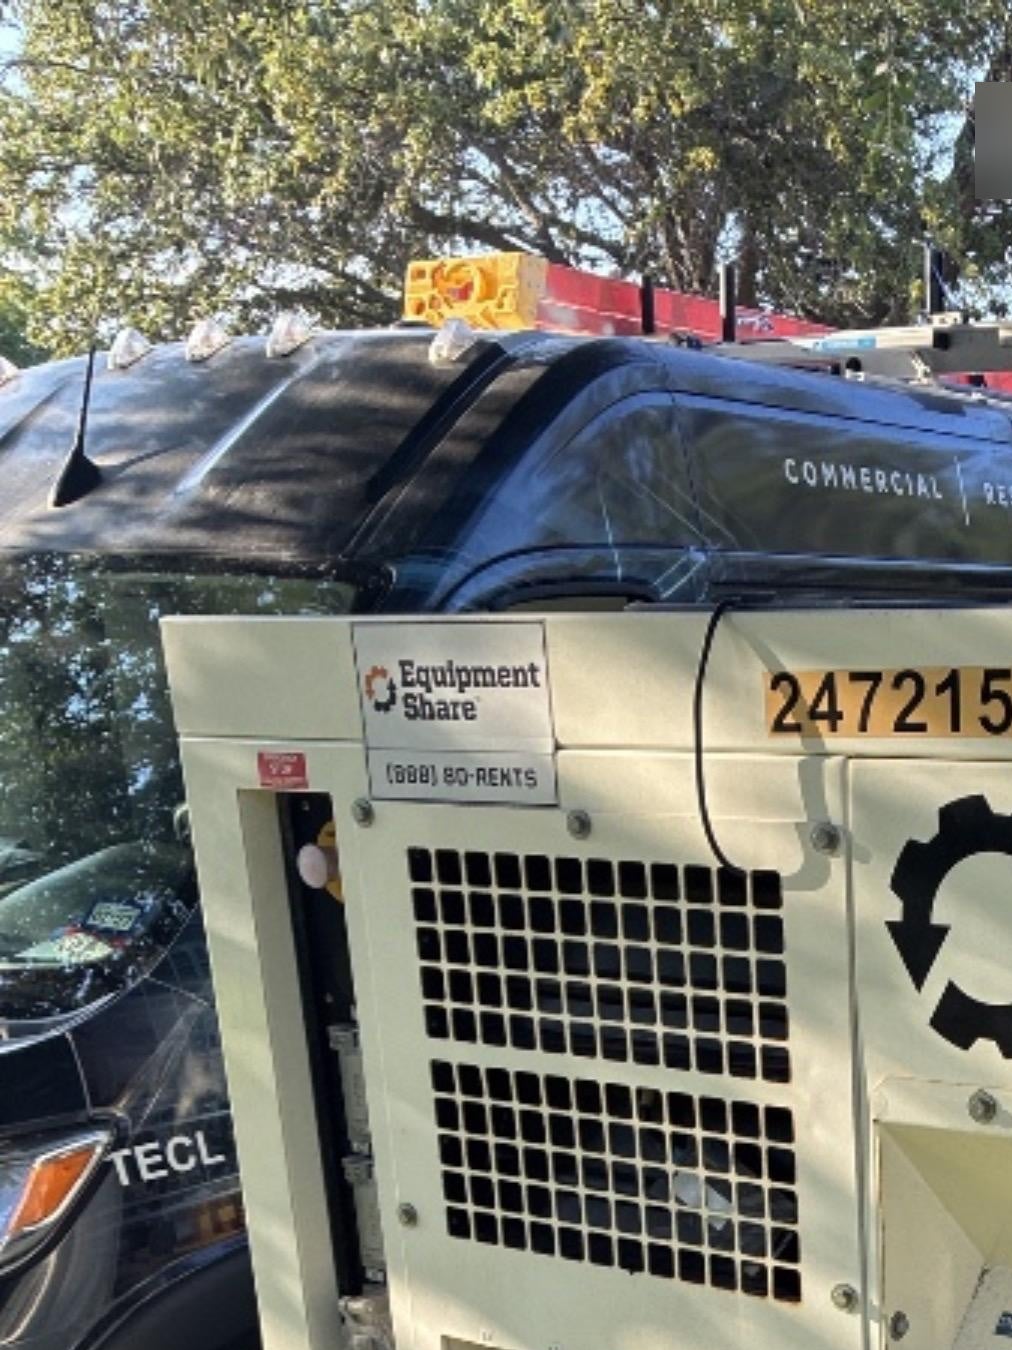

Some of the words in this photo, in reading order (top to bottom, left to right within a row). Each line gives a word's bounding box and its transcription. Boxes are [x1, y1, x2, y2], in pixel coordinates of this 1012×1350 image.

[783, 457, 944, 499] COMMERCIAL
[398, 659, 541, 693] Equipment
[403, 692, 478, 721] Share
[386, 763, 437, 786] (888)
[443, 766, 539, 790] 80-RENTS
[106, 1130, 225, 1187] TECL
